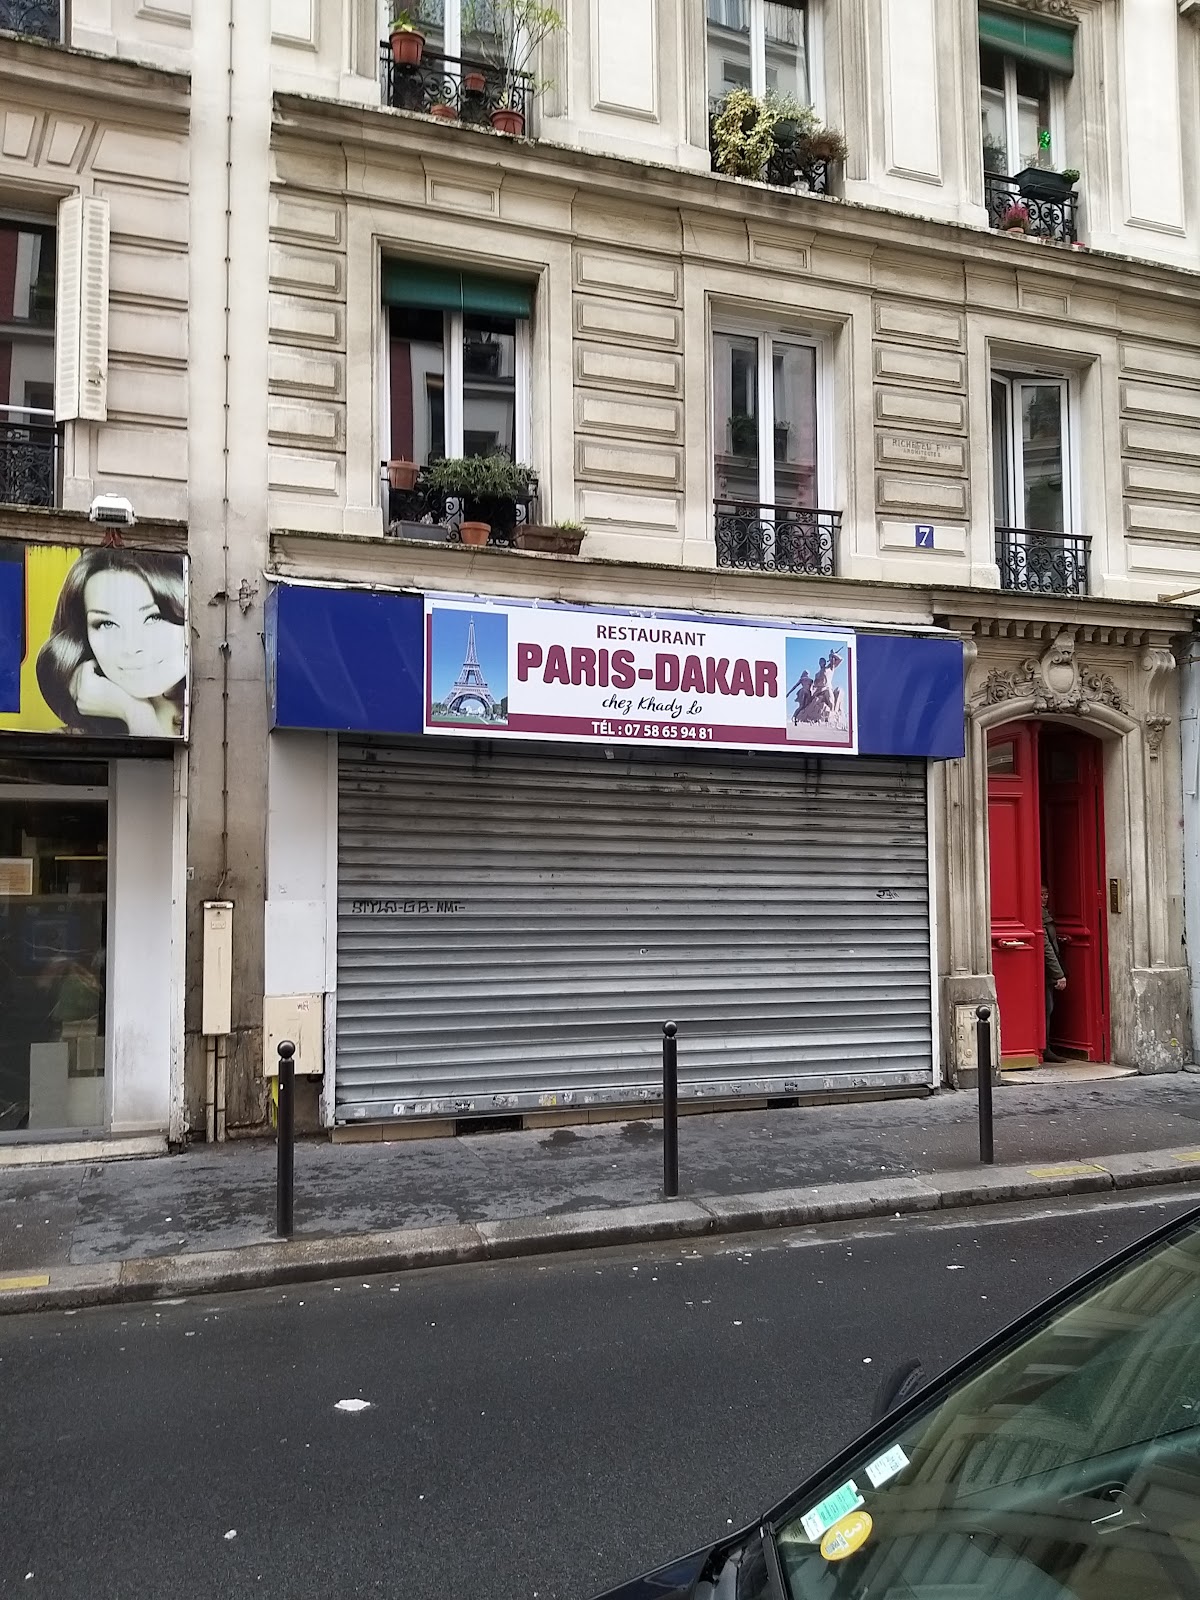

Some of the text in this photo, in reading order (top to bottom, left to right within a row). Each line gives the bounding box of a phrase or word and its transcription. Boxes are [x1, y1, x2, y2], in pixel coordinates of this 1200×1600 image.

[919, 528, 930, 546] 7
[596, 625, 706, 646] RESTAURANT
[517, 642, 778, 698] PARIS-DAKAR
[602, 694, 702, 718] chez Khady Lo
[624, 723, 640, 736] 07
[644, 725, 660, 737] 58
[662, 726, 678, 738] 65
[681, 727, 697, 739] 94
[699, 728, 713, 740] 81
